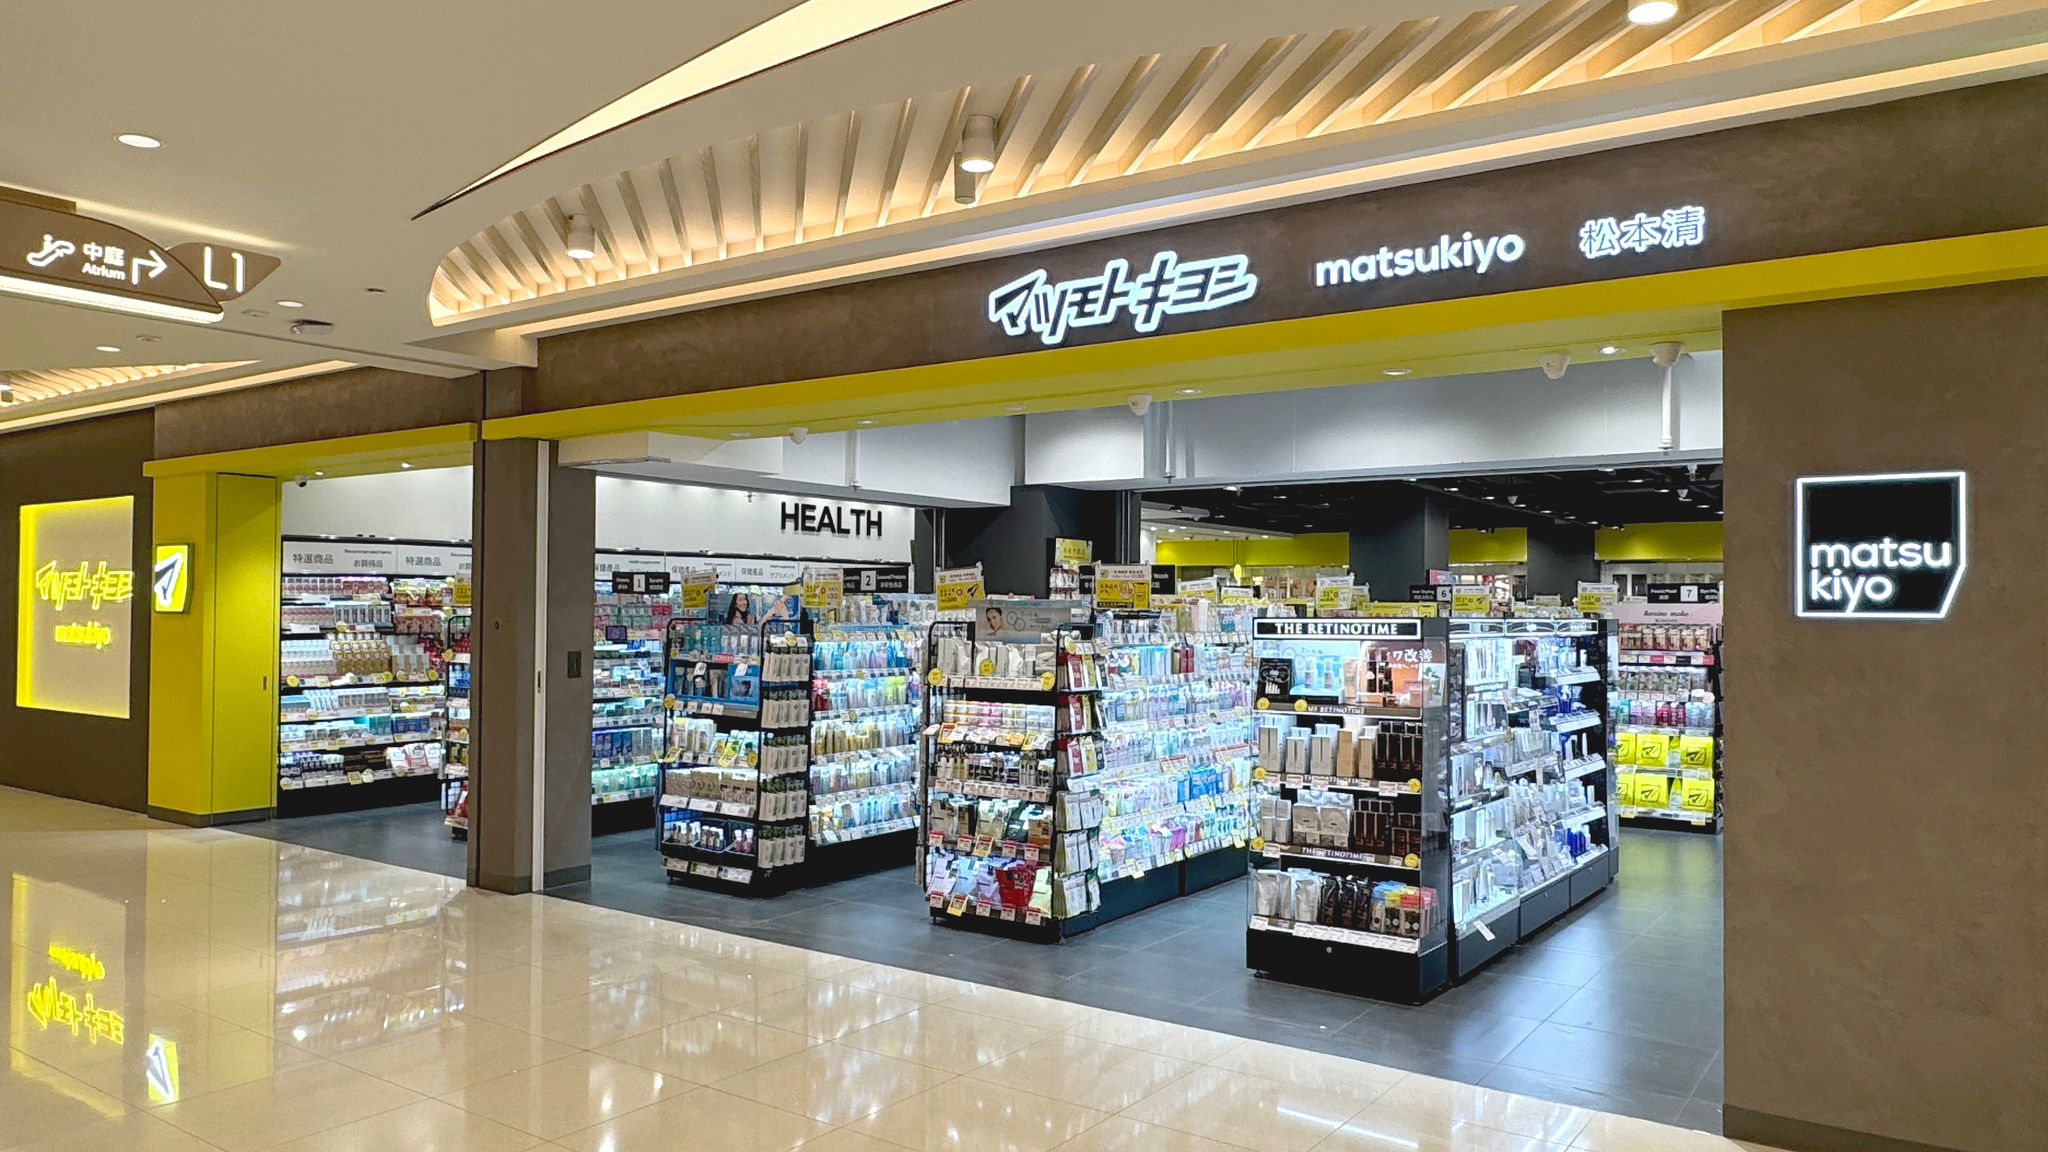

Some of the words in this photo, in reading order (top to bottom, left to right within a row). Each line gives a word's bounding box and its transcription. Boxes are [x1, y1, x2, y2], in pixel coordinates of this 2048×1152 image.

[1580, 206, 1706, 260] 松本清
[83, 242, 125, 267] 中庭
[1316, 231, 1525, 287] matsukiyo
[81, 263, 126, 281] Atrium
[204, 246, 244, 293] L1
[781, 501, 882, 537] HEALTH
[1811, 536, 1952, 568] matsu
[865, 575, 871, 586] 2
[1441, 590, 1447, 598] 6
[1685, 589, 1692, 598] 7
[1811, 568, 1894, 614] kiyo
[1275, 623, 1303, 634] THE
[1308, 623, 1398, 635] RETINOTIME
